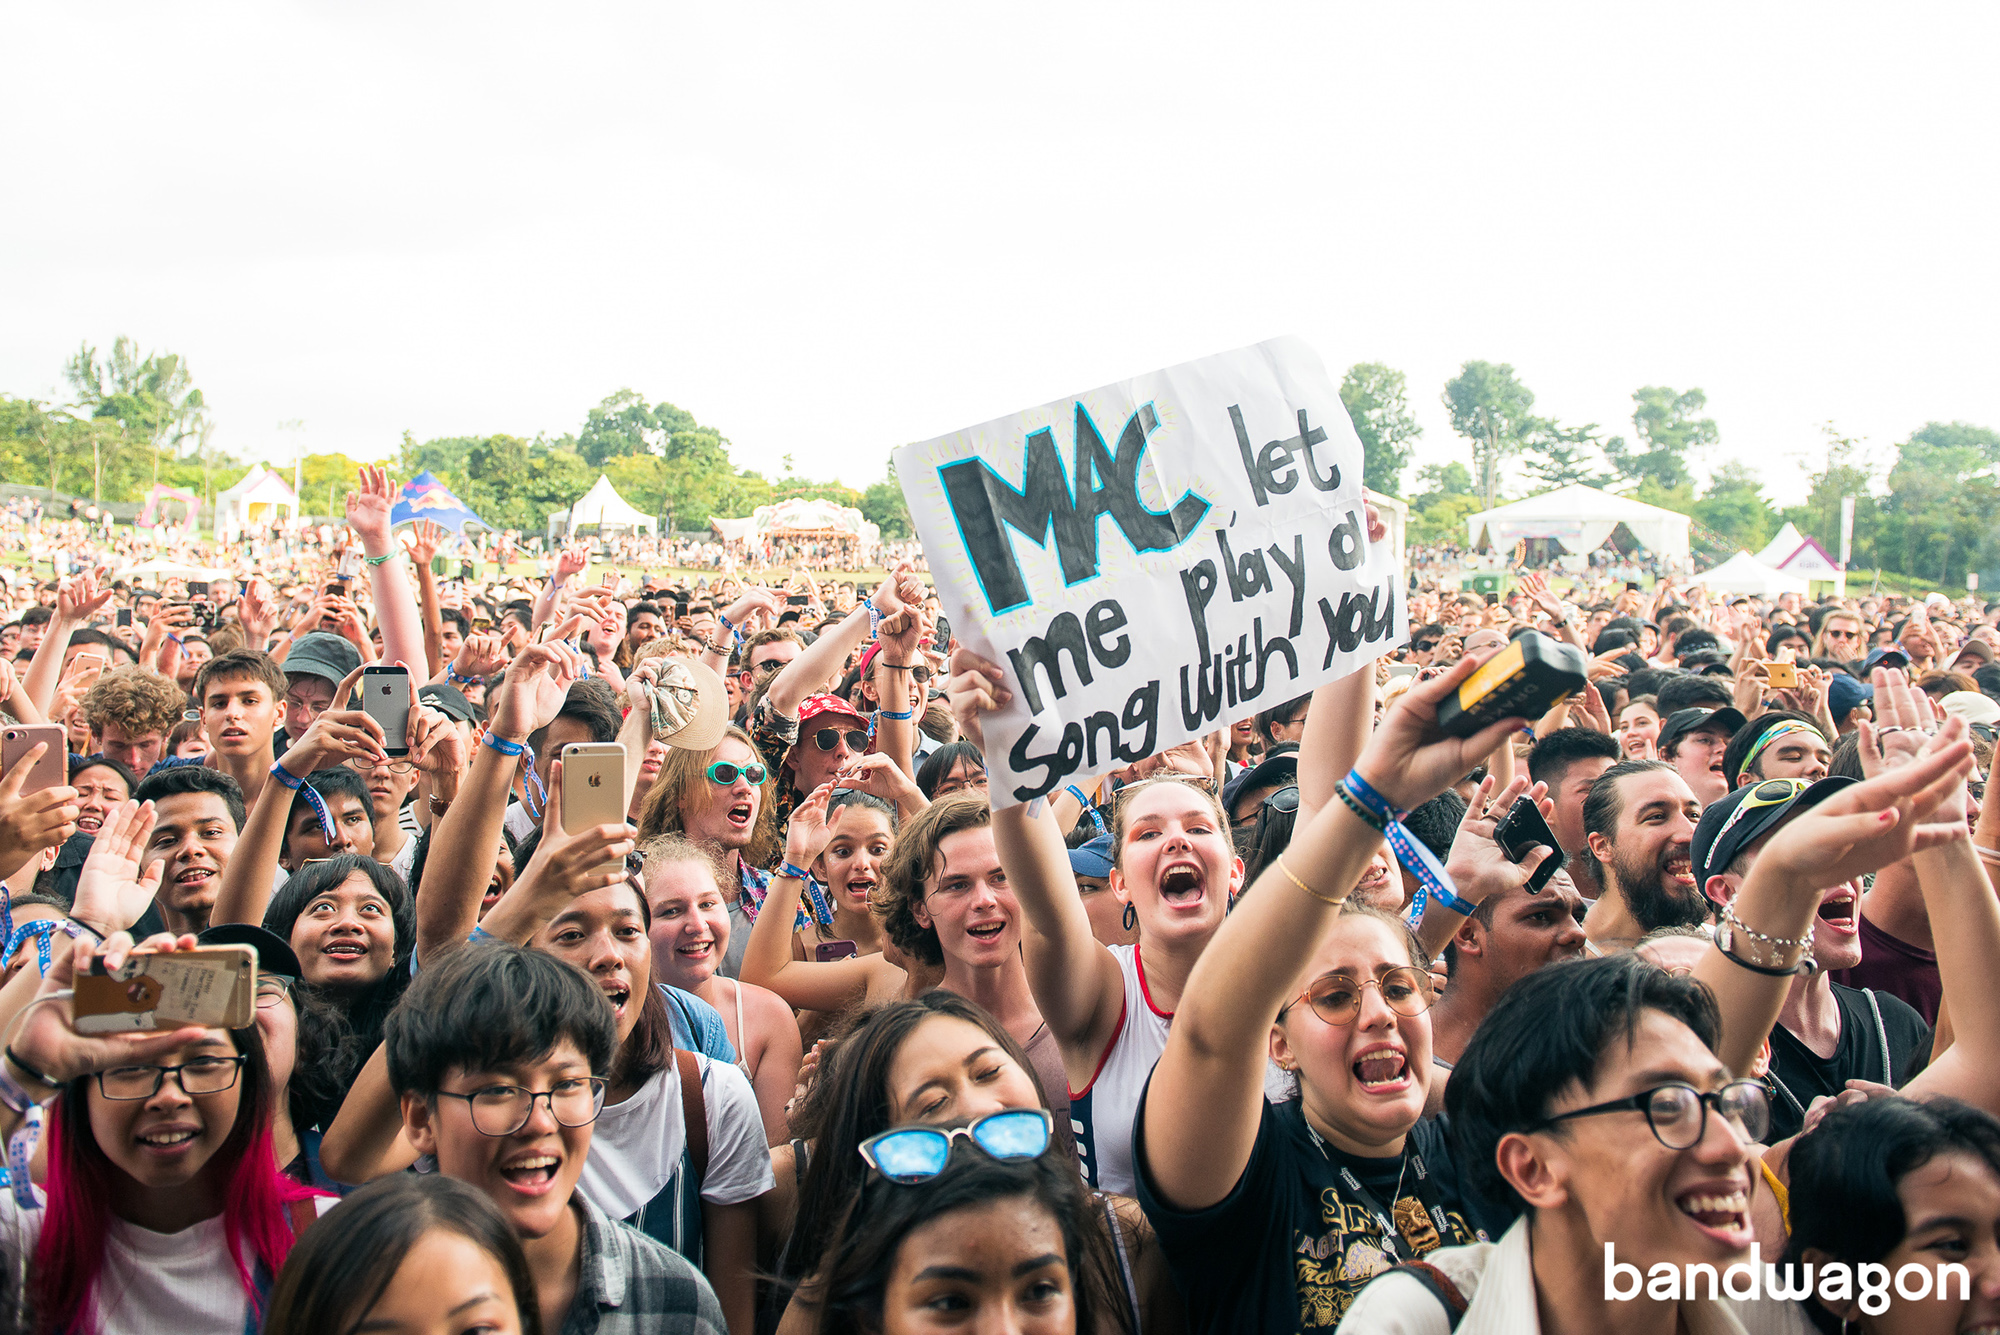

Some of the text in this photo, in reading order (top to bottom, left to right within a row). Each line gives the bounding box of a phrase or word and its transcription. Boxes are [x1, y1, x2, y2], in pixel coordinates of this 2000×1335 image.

[1227, 404, 1341, 507] let
[1006, 598, 1132, 717] me
[1179, 529, 1305, 668] play
[1318, 574, 1394, 671] you
